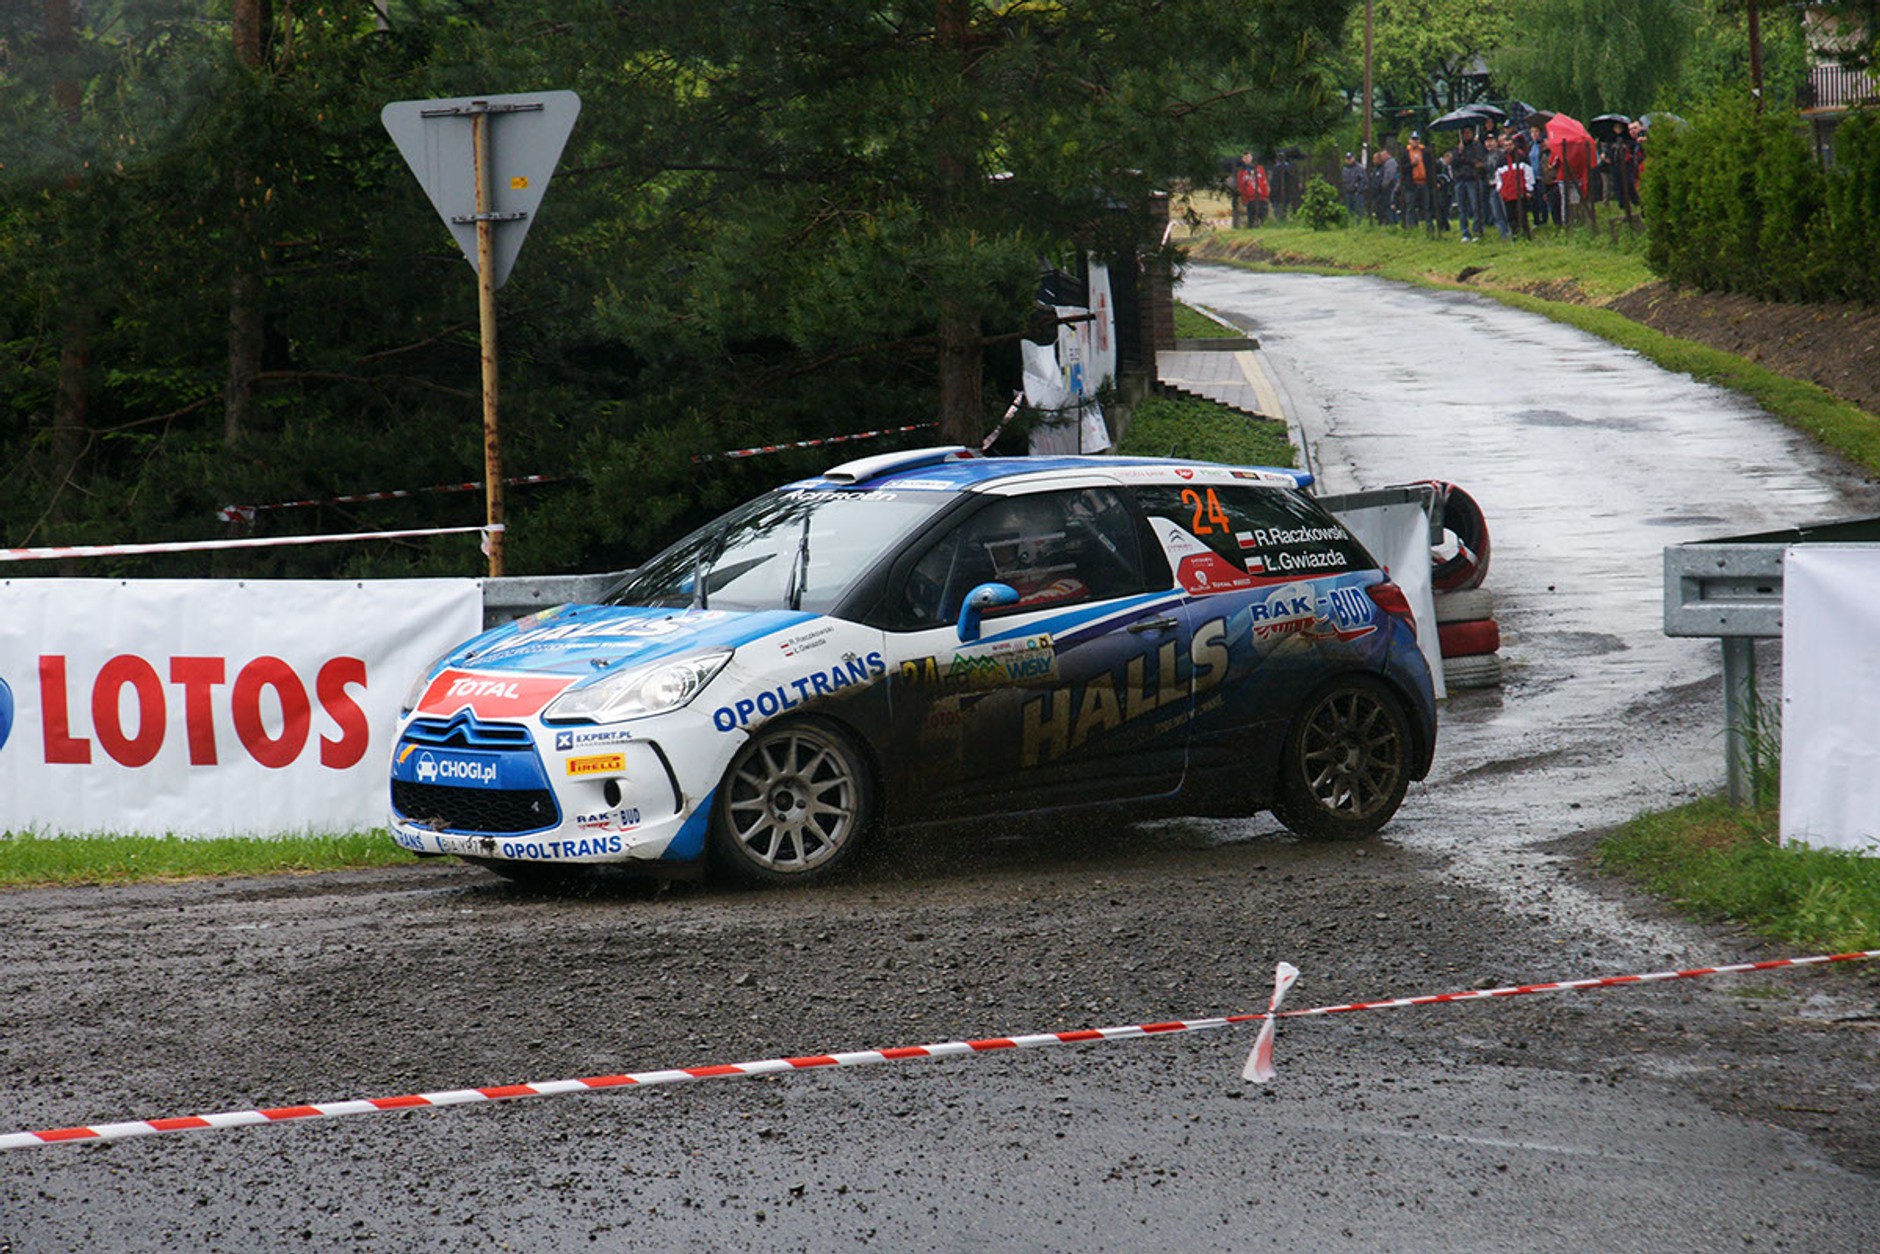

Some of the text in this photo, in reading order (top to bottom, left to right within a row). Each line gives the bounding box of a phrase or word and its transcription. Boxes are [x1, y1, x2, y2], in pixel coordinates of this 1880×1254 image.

[1181, 487, 1230, 535] 24
[1251, 596, 1312, 621] RAK
[1329, 588, 1371, 626] BUD
[447, 677, 520, 699] TOTAL
[713, 651, 887, 732] OPOLTRANS
[1021, 616, 1230, 769] HALLS
[39, 653, 370, 769] LOTOS
[576, 731, 632, 743] EXPERT.PL
[438, 760, 497, 784] CHOGI.pl
[570, 755, 621, 772] PIRELLI
[577, 812, 609, 823] RAK
[620, 808, 640, 825] BUD
[504, 835, 622, 859] OPOLTRANS
